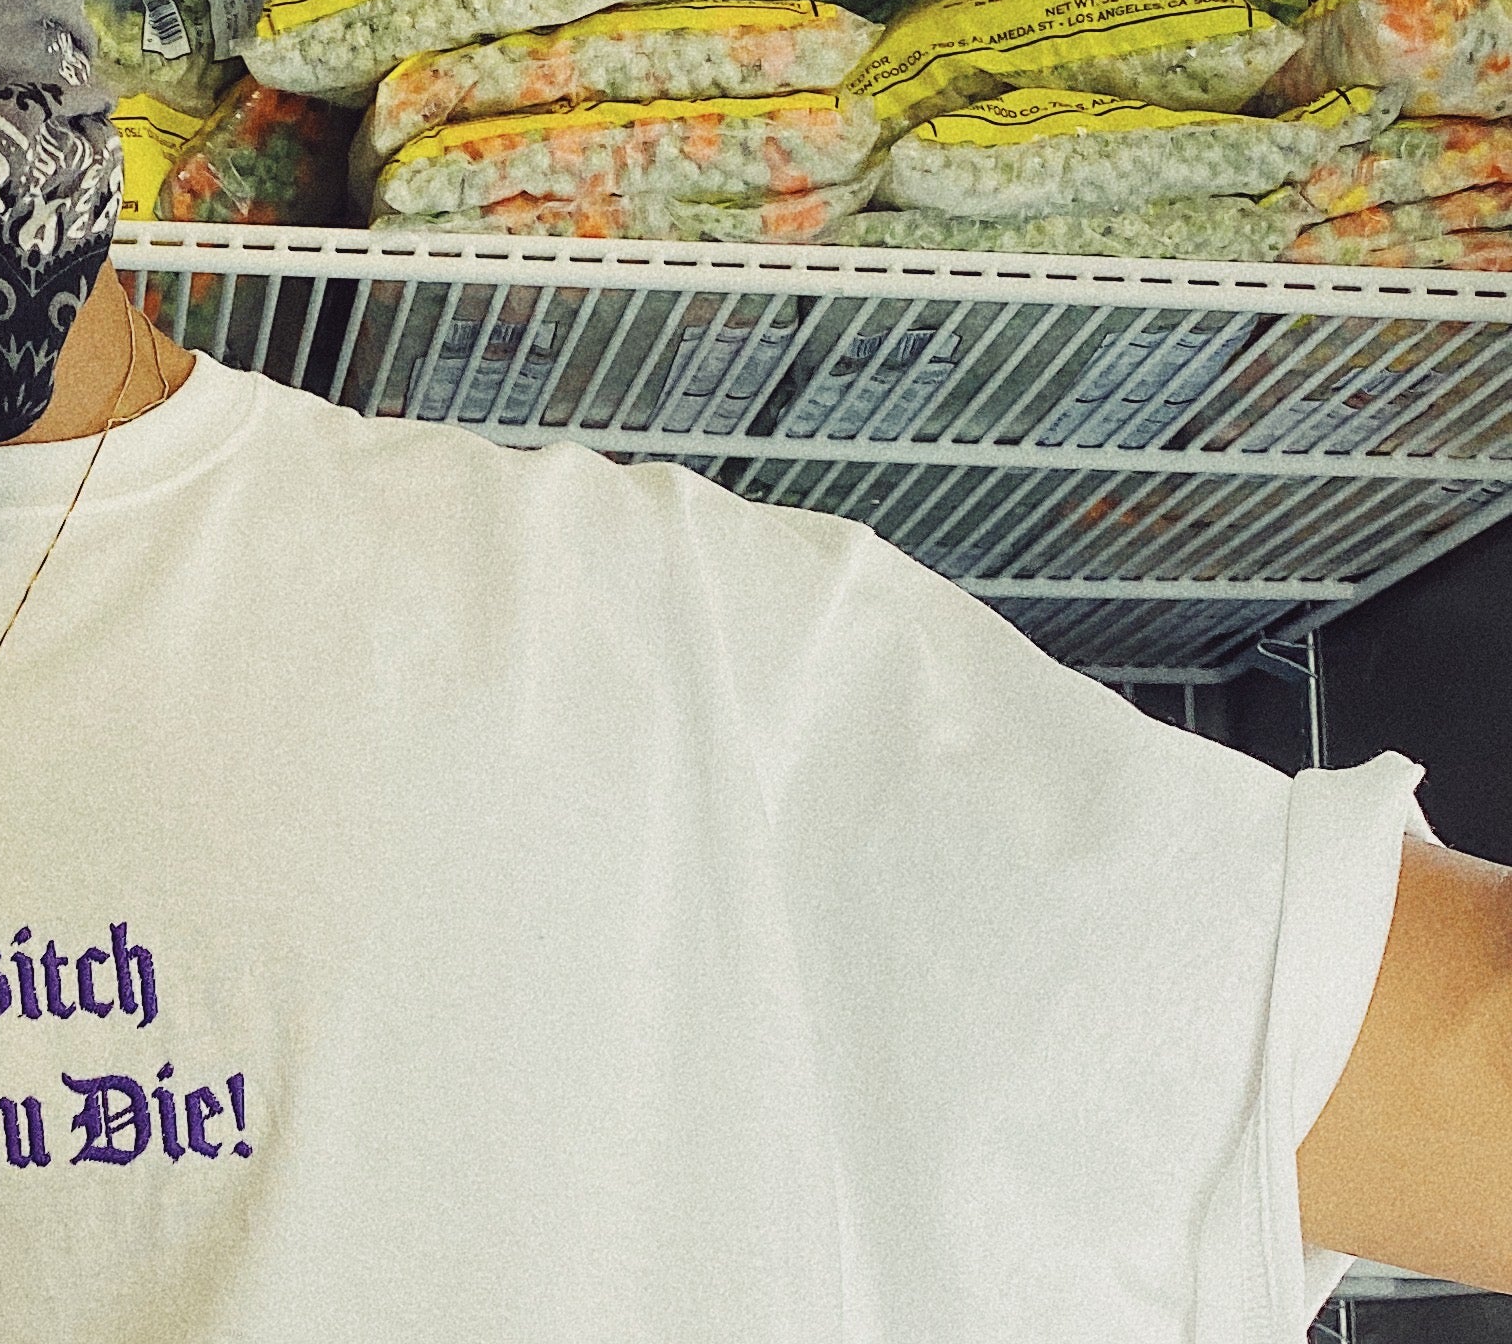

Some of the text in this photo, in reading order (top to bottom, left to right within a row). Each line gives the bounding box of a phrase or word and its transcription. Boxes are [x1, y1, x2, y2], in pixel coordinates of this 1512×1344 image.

[1045, 2, 1071, 18] NET
[873, 62, 908, 84] FOOD
[1038, 20, 1055, 32] ST
[1067, 12, 1094, 27] LOS
[865, 55, 891, 74] FOR
[987, 105, 1017, 119] FOOD
[61, 1062, 254, 1166] Die!
